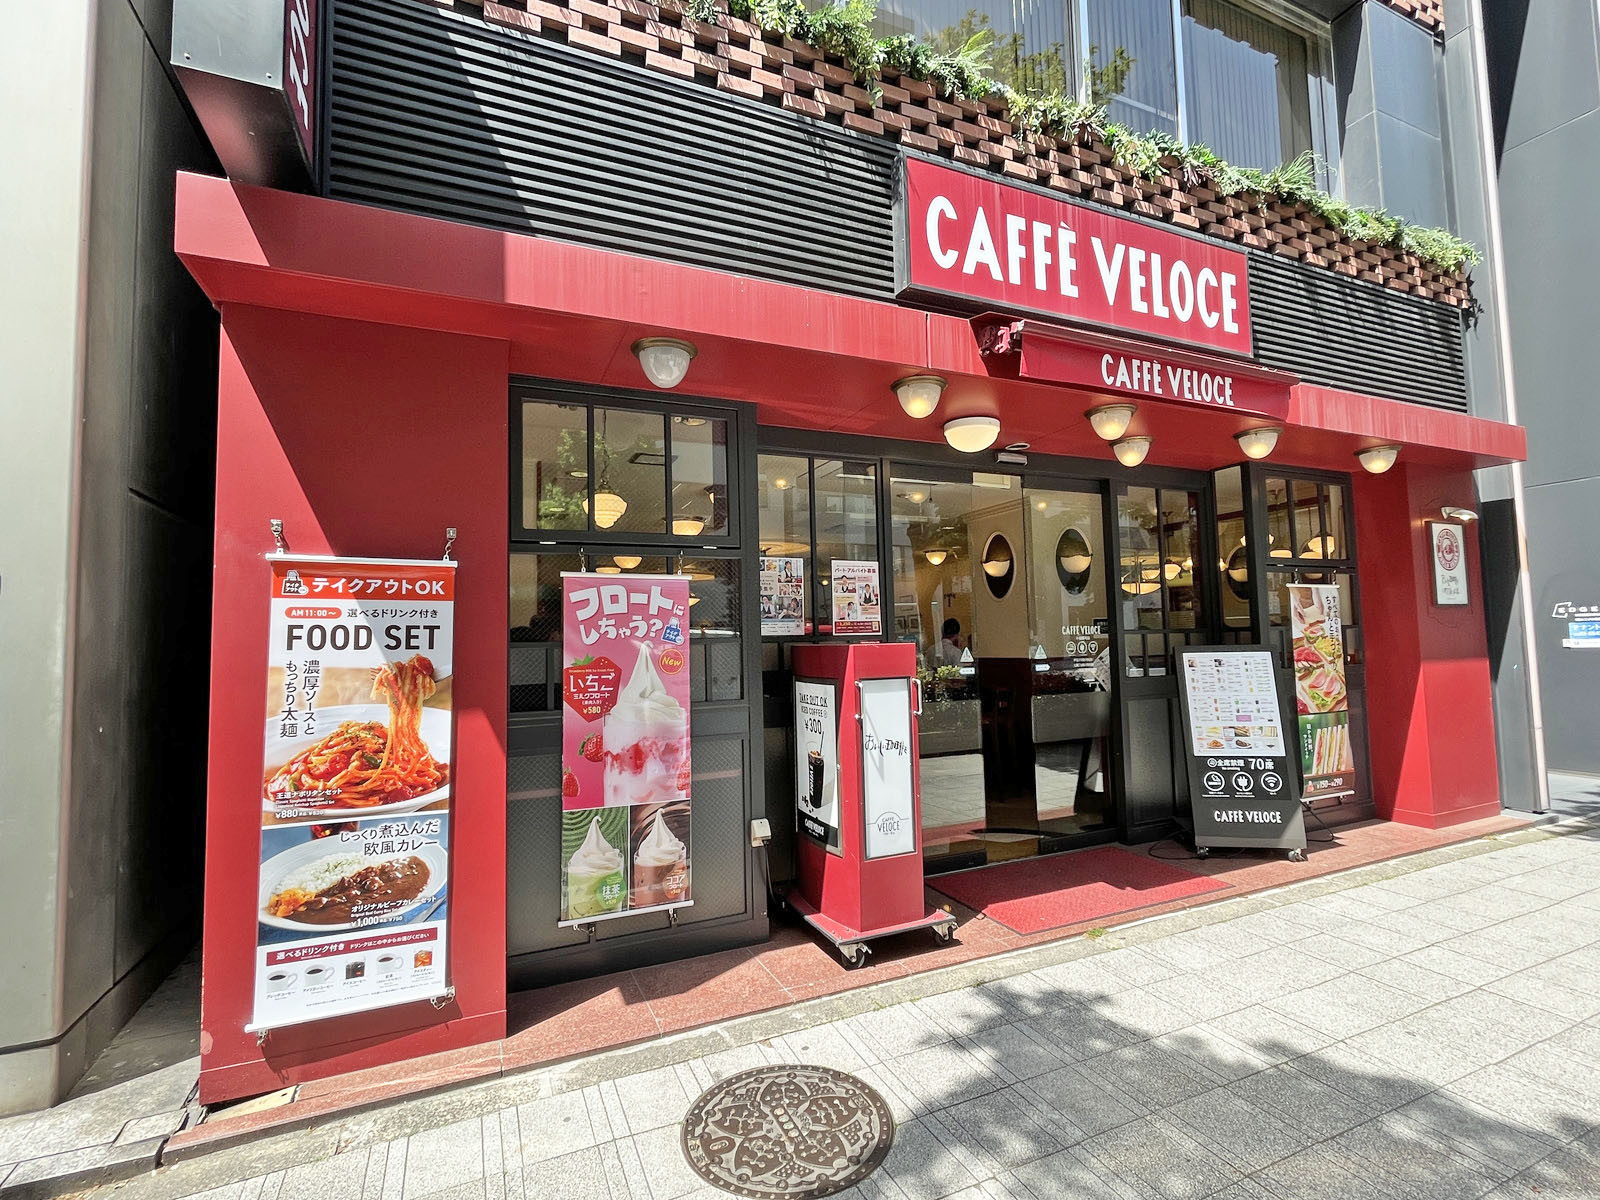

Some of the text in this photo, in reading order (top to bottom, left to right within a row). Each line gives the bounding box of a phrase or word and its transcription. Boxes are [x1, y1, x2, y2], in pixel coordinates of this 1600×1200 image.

[926, 195, 1239, 334] CAFFÈ VELOCE
[1101, 353, 1234, 406] CAFFÈ VELOCE
[312, 578, 445, 595] テイクアウトOK
[569, 585, 685, 621] フロートに
[347, 608, 439, 618] 選べるドリンク付き
[286, 624, 441, 651] FOOD SET
[579, 616, 663, 645] しちゃう?
[1080, 626, 1100, 635] VELOCE
[662, 657, 681, 666] New
[570, 672, 615, 692] いちご
[280, 660, 298, 738] もっちり太麺
[302, 660, 320, 735] 濃厚ソースと
[573, 692, 610, 700] ミルクフロート
[583, 706, 601, 714] ¥580
[804, 718, 822, 734] ¥300
[276, 788, 342, 799] 王道ナポリタンセット
[276, 809, 298, 818] ¥880
[1245, 811, 1282, 823] VELOCE
[340, 820, 440, 842] じっくり煮込んだ
[878, 821, 899, 832] VELOCE
[364, 839, 437, 856] 欧風カレー
[667, 874, 686, 887] ココア
[602, 884, 620, 895] 抹茶
[351, 897, 437, 912] オリジナルビーフカレーセット
[351, 916, 379, 927] ¥1,000
[350, 933, 430, 949] ドリンクはこの中からお選びください
[276, 943, 345, 960] 選べるドリンク付き
